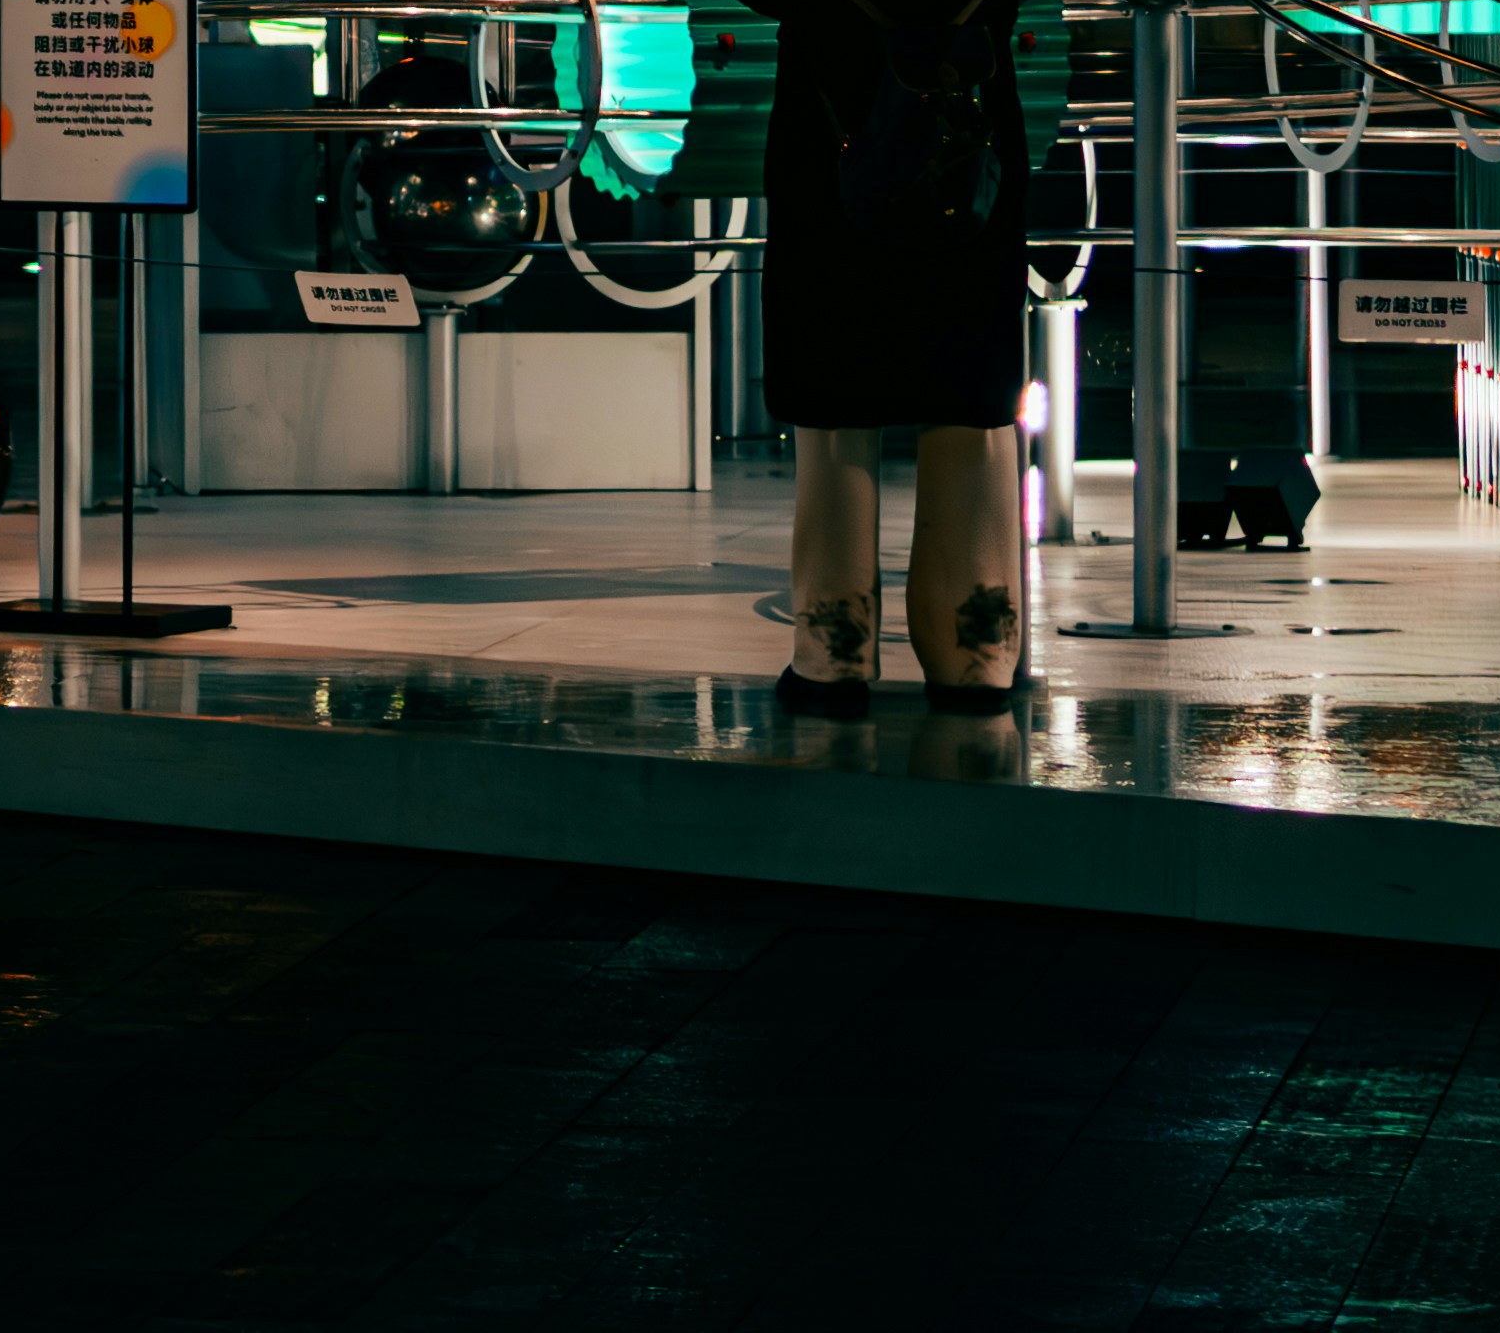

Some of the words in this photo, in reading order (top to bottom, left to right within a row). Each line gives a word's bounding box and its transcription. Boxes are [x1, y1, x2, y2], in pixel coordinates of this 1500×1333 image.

[51, 11, 137, 29] 或任何物品
[34, 35, 155, 54] 阻挡或干扰小球
[34, 59, 155, 78] 在轨道内的滚动
[37, 91, 61, 99] Please
[63, 91, 73, 99] do
[74, 92, 89, 100] not
[34, 102, 54, 112] body
[91, 116, 105, 124] the
[63, 128, 86, 137] along
[87, 128, 100, 136] the
[311, 286, 399, 303] 请勿越过围栏
[330, 304, 342, 312] DO
[344, 305, 359, 313] NOT
[360, 305, 386, 314] CROSS
[1355, 295, 1468, 315] 请勿越过围栏
[1375, 318, 1390, 327] DO
[1392, 318, 1411, 327] NOT
[1413, 319, 1446, 328] CROSS
